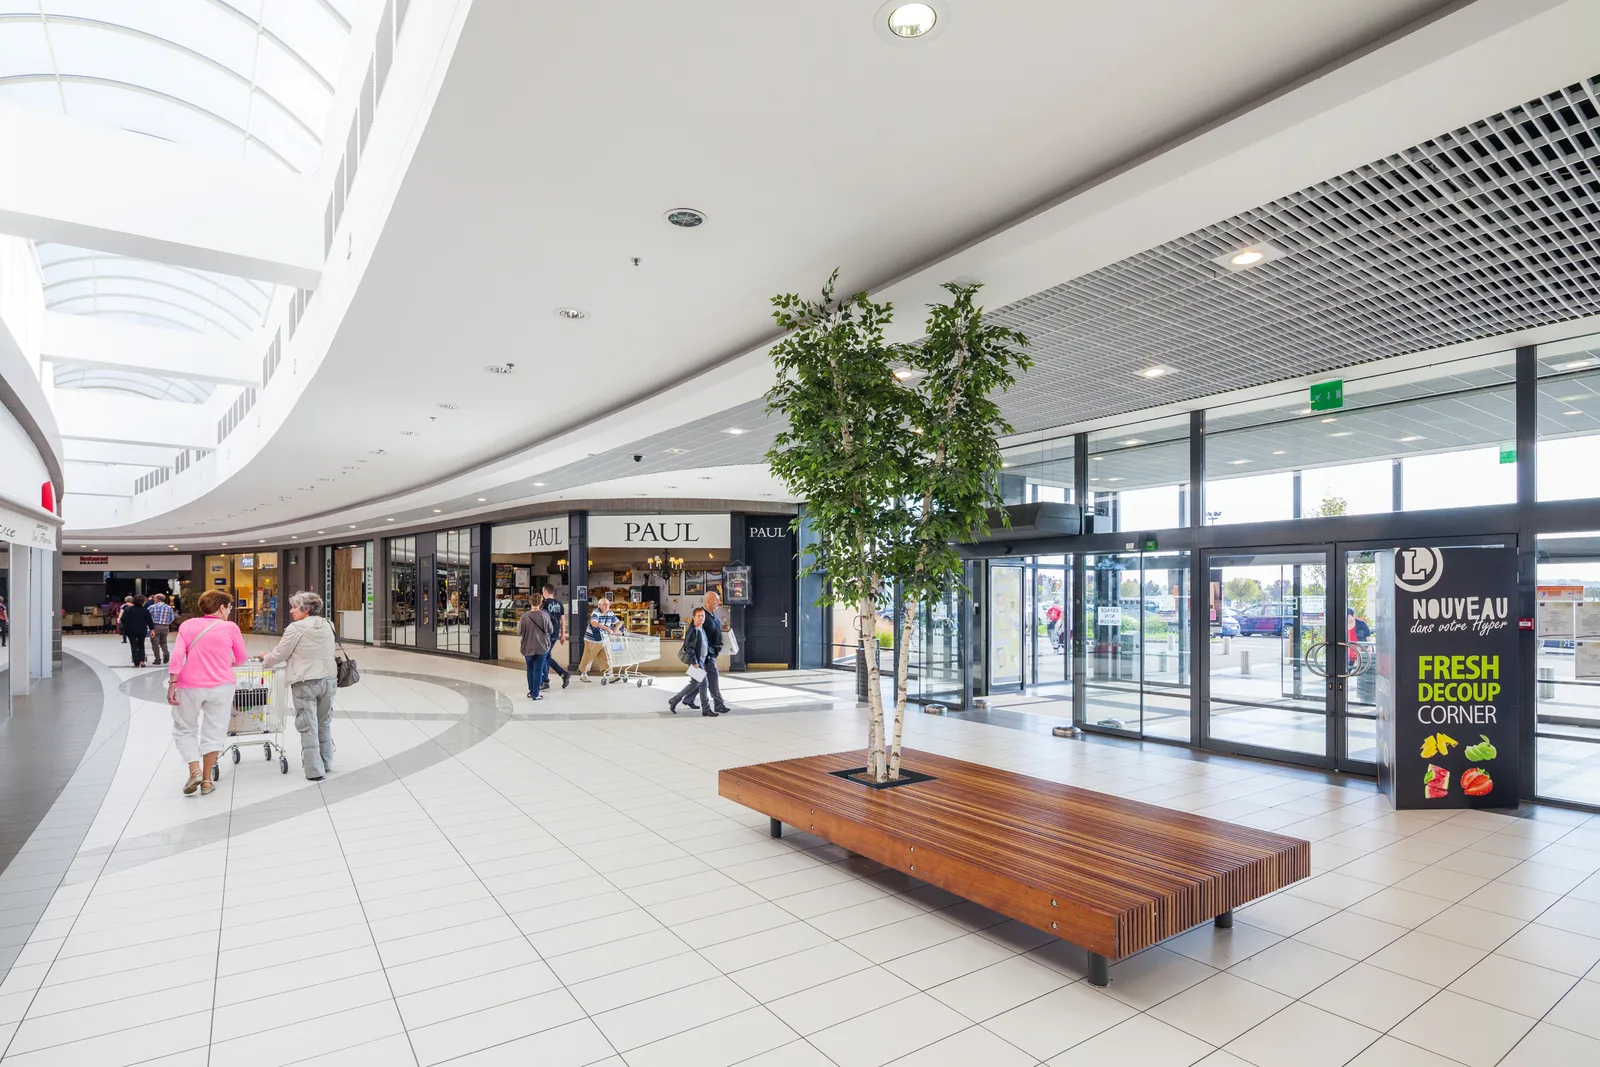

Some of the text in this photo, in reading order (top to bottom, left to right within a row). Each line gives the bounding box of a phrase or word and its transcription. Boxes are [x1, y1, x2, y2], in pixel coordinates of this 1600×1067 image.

[528, 527, 563, 547] PAUL
[624, 522, 700, 542] PAUL
[749, 527, 787, 539] PAUL
[1413, 596, 1508, 620] NOUVEAU
[1410, 615, 1508, 637] dans votre Hyper
[1418, 655, 1500, 680] FRESH
[1418, 682, 1501, 703] DECOUP
[1418, 704, 1497, 725] CORNER
